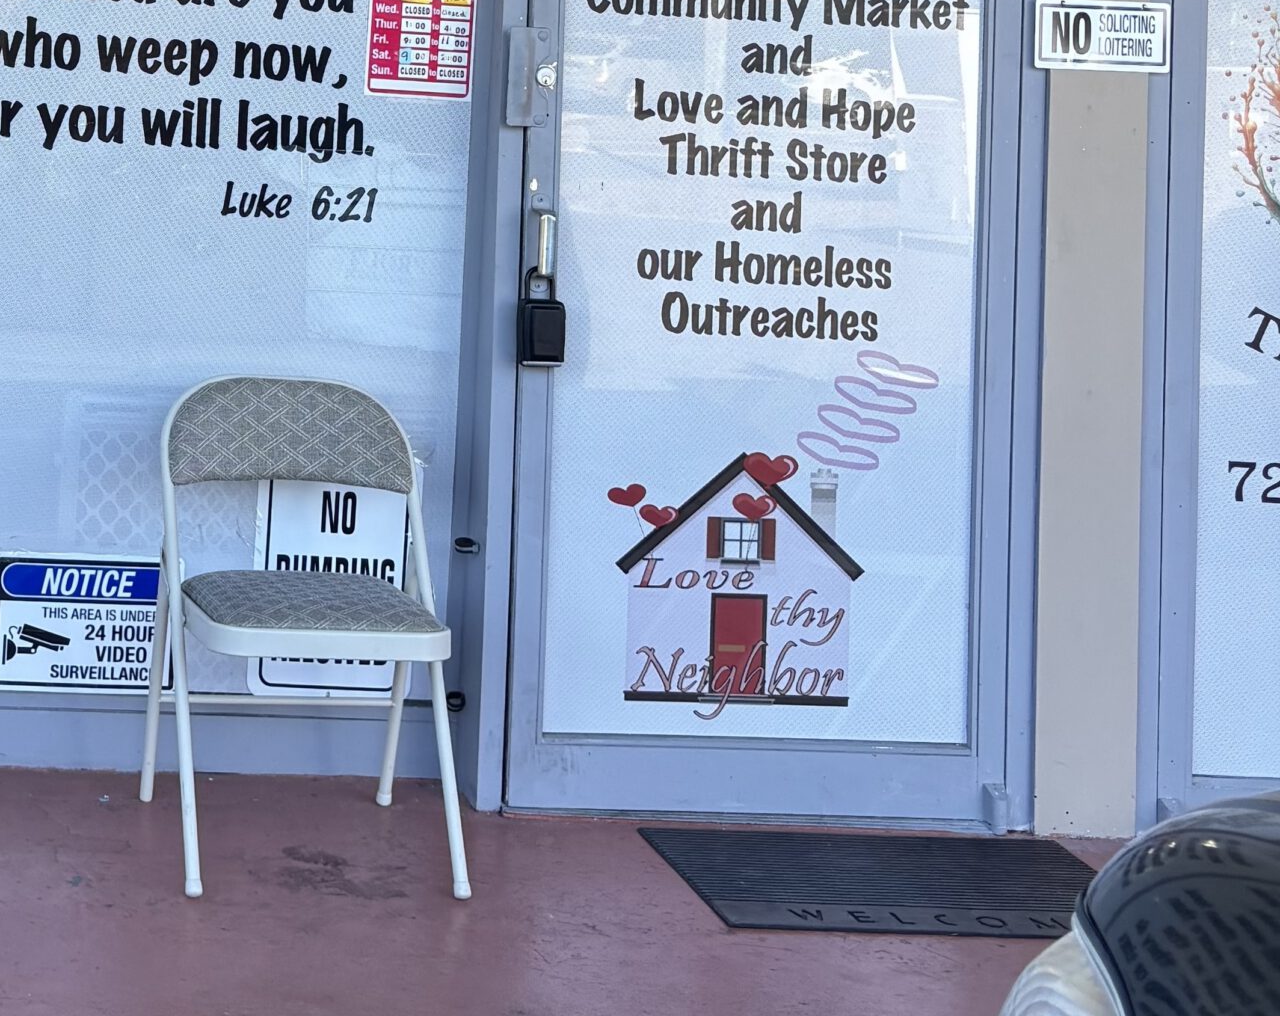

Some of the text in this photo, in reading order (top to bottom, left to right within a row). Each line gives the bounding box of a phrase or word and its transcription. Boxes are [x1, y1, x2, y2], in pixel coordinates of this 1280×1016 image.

[375, 3, 430, 15] Wed. CLOSED
[375, 19, 398, 29] Thur.
[373, 33, 388, 44] Fri.
[1051, 11, 1155, 55] NO SOLICITING
[1098, 37, 1153, 57] LOITERING
[97, 35, 218, 86] weep
[233, 41, 347, 89] now,
[371, 64, 393, 75] Sun.
[439, 69, 464, 77] CLOSED
[372, 49, 391, 60] Sat.
[741, 35, 812, 75] and
[635, 78, 914, 139] Love and Hope
[37, 103, 125, 150] you
[141, 98, 222, 149] will
[237, 100, 374, 163] laugh.
[660, 133, 886, 184] Thrift Store
[221, 181, 378, 222] Luke 6:21
[731, 192, 802, 233] and
[638, 241, 891, 289] our Homeless
[662, 292, 877, 341] Outreaches
[321, 491, 357, 535] NO
[41, 567, 136, 598] NOTICE
[633, 557, 755, 590] Love
[42, 607, 68, 619] THIS
[71, 608, 102, 621] AREA
[106, 610, 117, 621] IS
[85, 625, 105, 641] 24
[770, 589, 846, 647] thy
[96, 646, 147, 663] VIDEO
[630, 640, 845, 720] Neighbor
